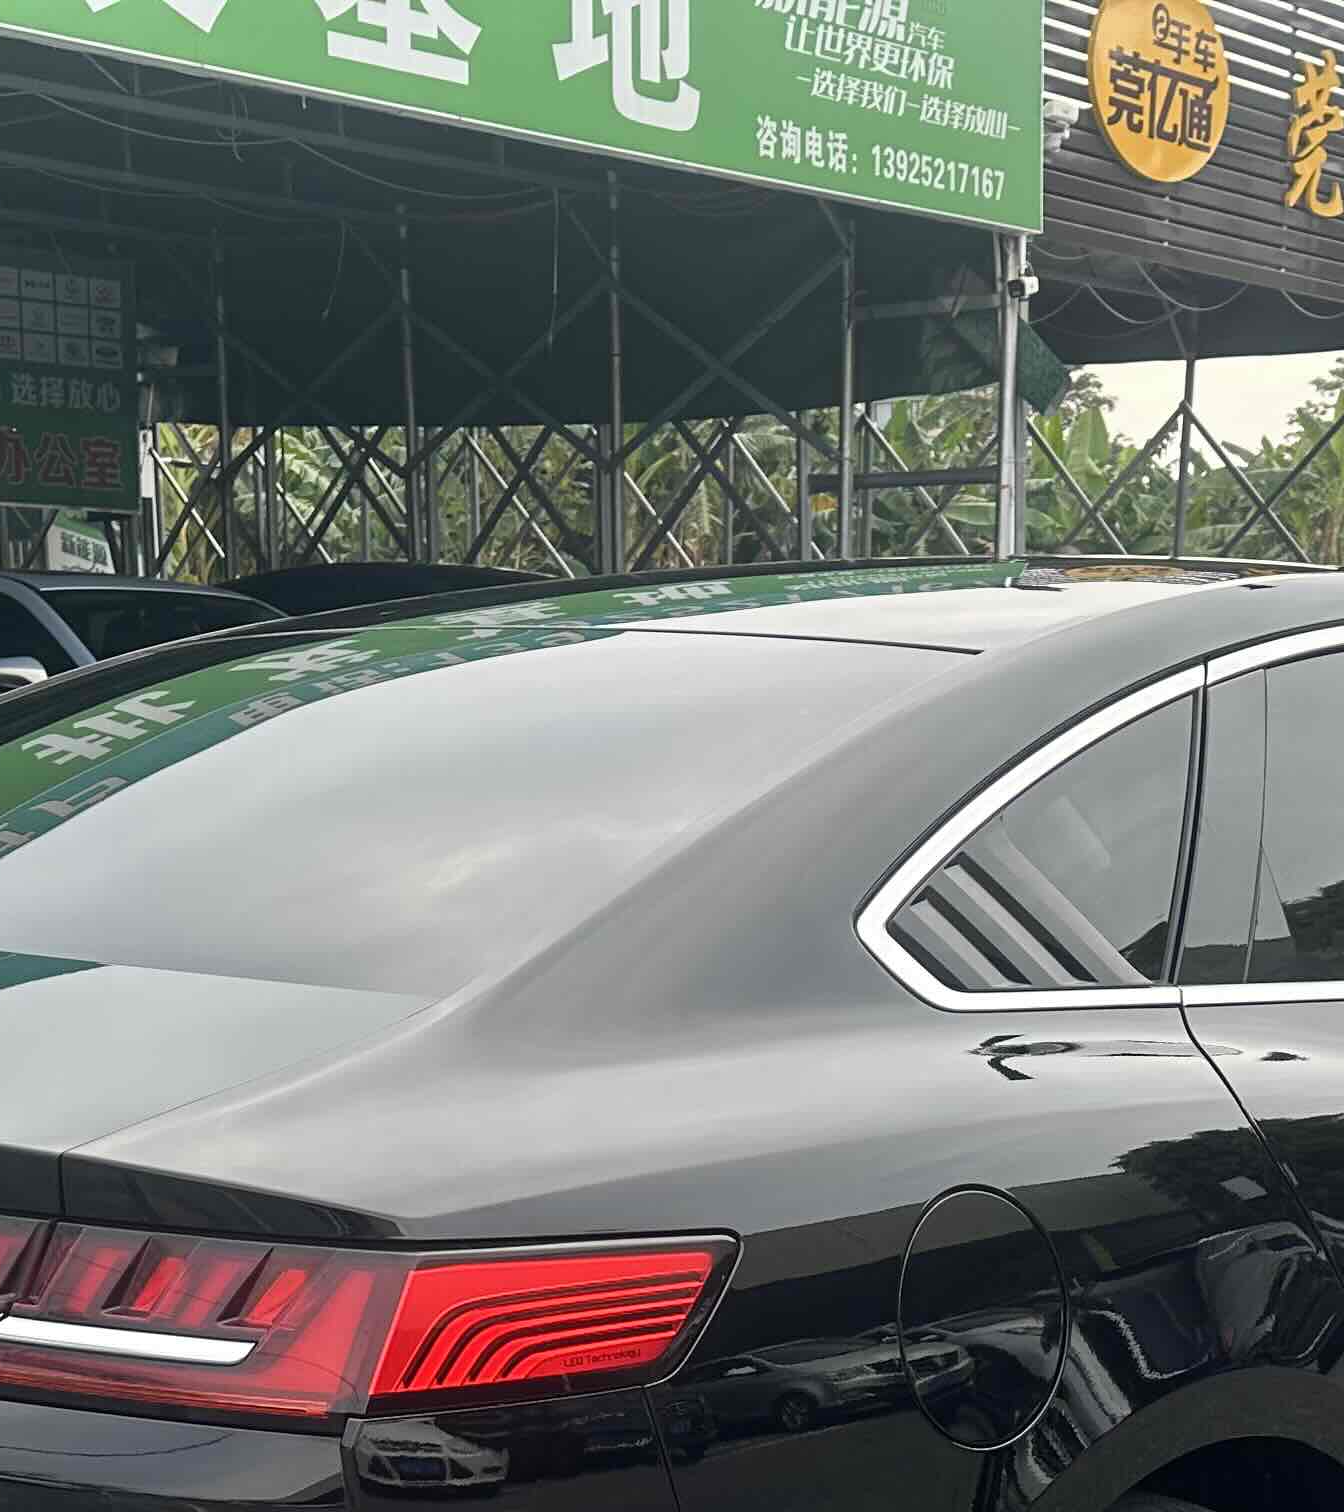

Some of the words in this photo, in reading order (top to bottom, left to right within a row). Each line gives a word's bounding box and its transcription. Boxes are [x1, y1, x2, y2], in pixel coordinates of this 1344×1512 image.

[784, 15, 955, 90] 让世界更环保
[1107, 46, 1219, 154] 莞亿通
[11, 371, 121, 413] 选择放心
